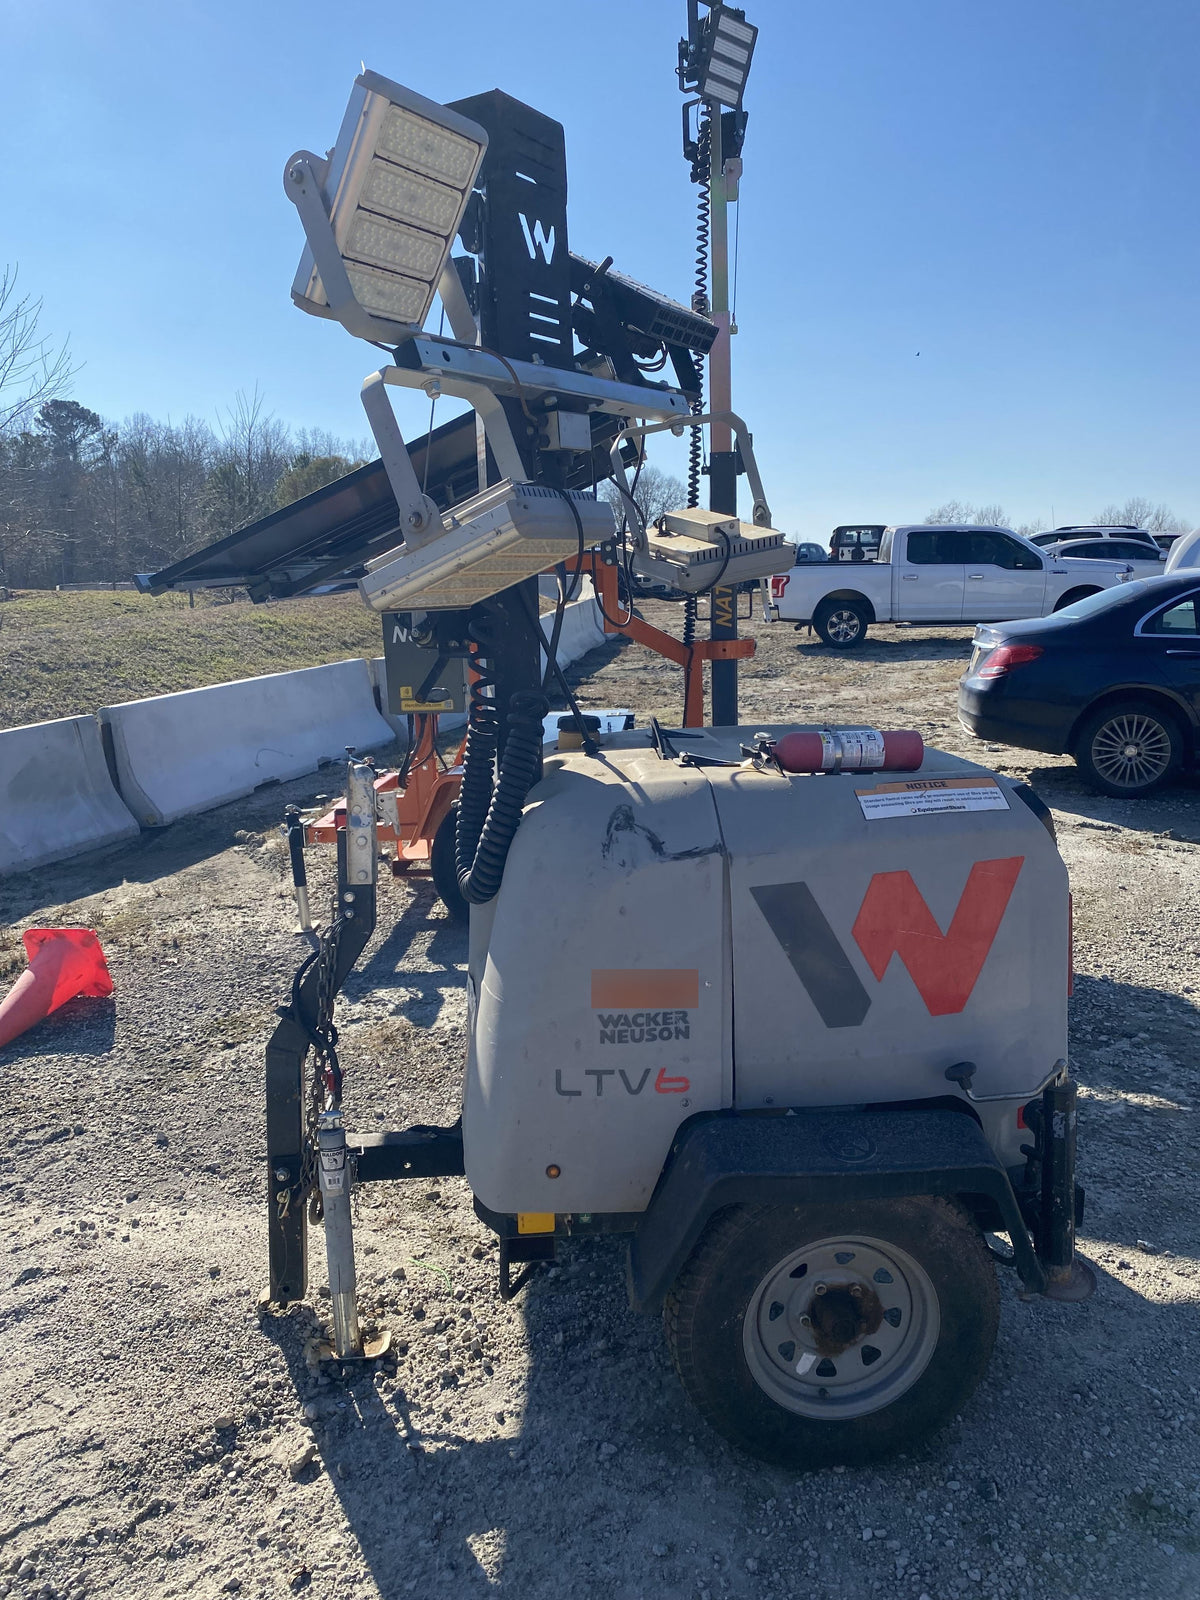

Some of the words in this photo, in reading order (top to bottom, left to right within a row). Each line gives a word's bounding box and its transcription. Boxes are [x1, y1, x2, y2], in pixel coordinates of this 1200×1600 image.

[906, 781, 948, 790] NOTICE
[749, 855, 1025, 1028] W
[597, 1010, 690, 1029] WACKER
[600, 1025, 690, 1044] NEUSON
[555, 1067, 690, 1097] LTV6
